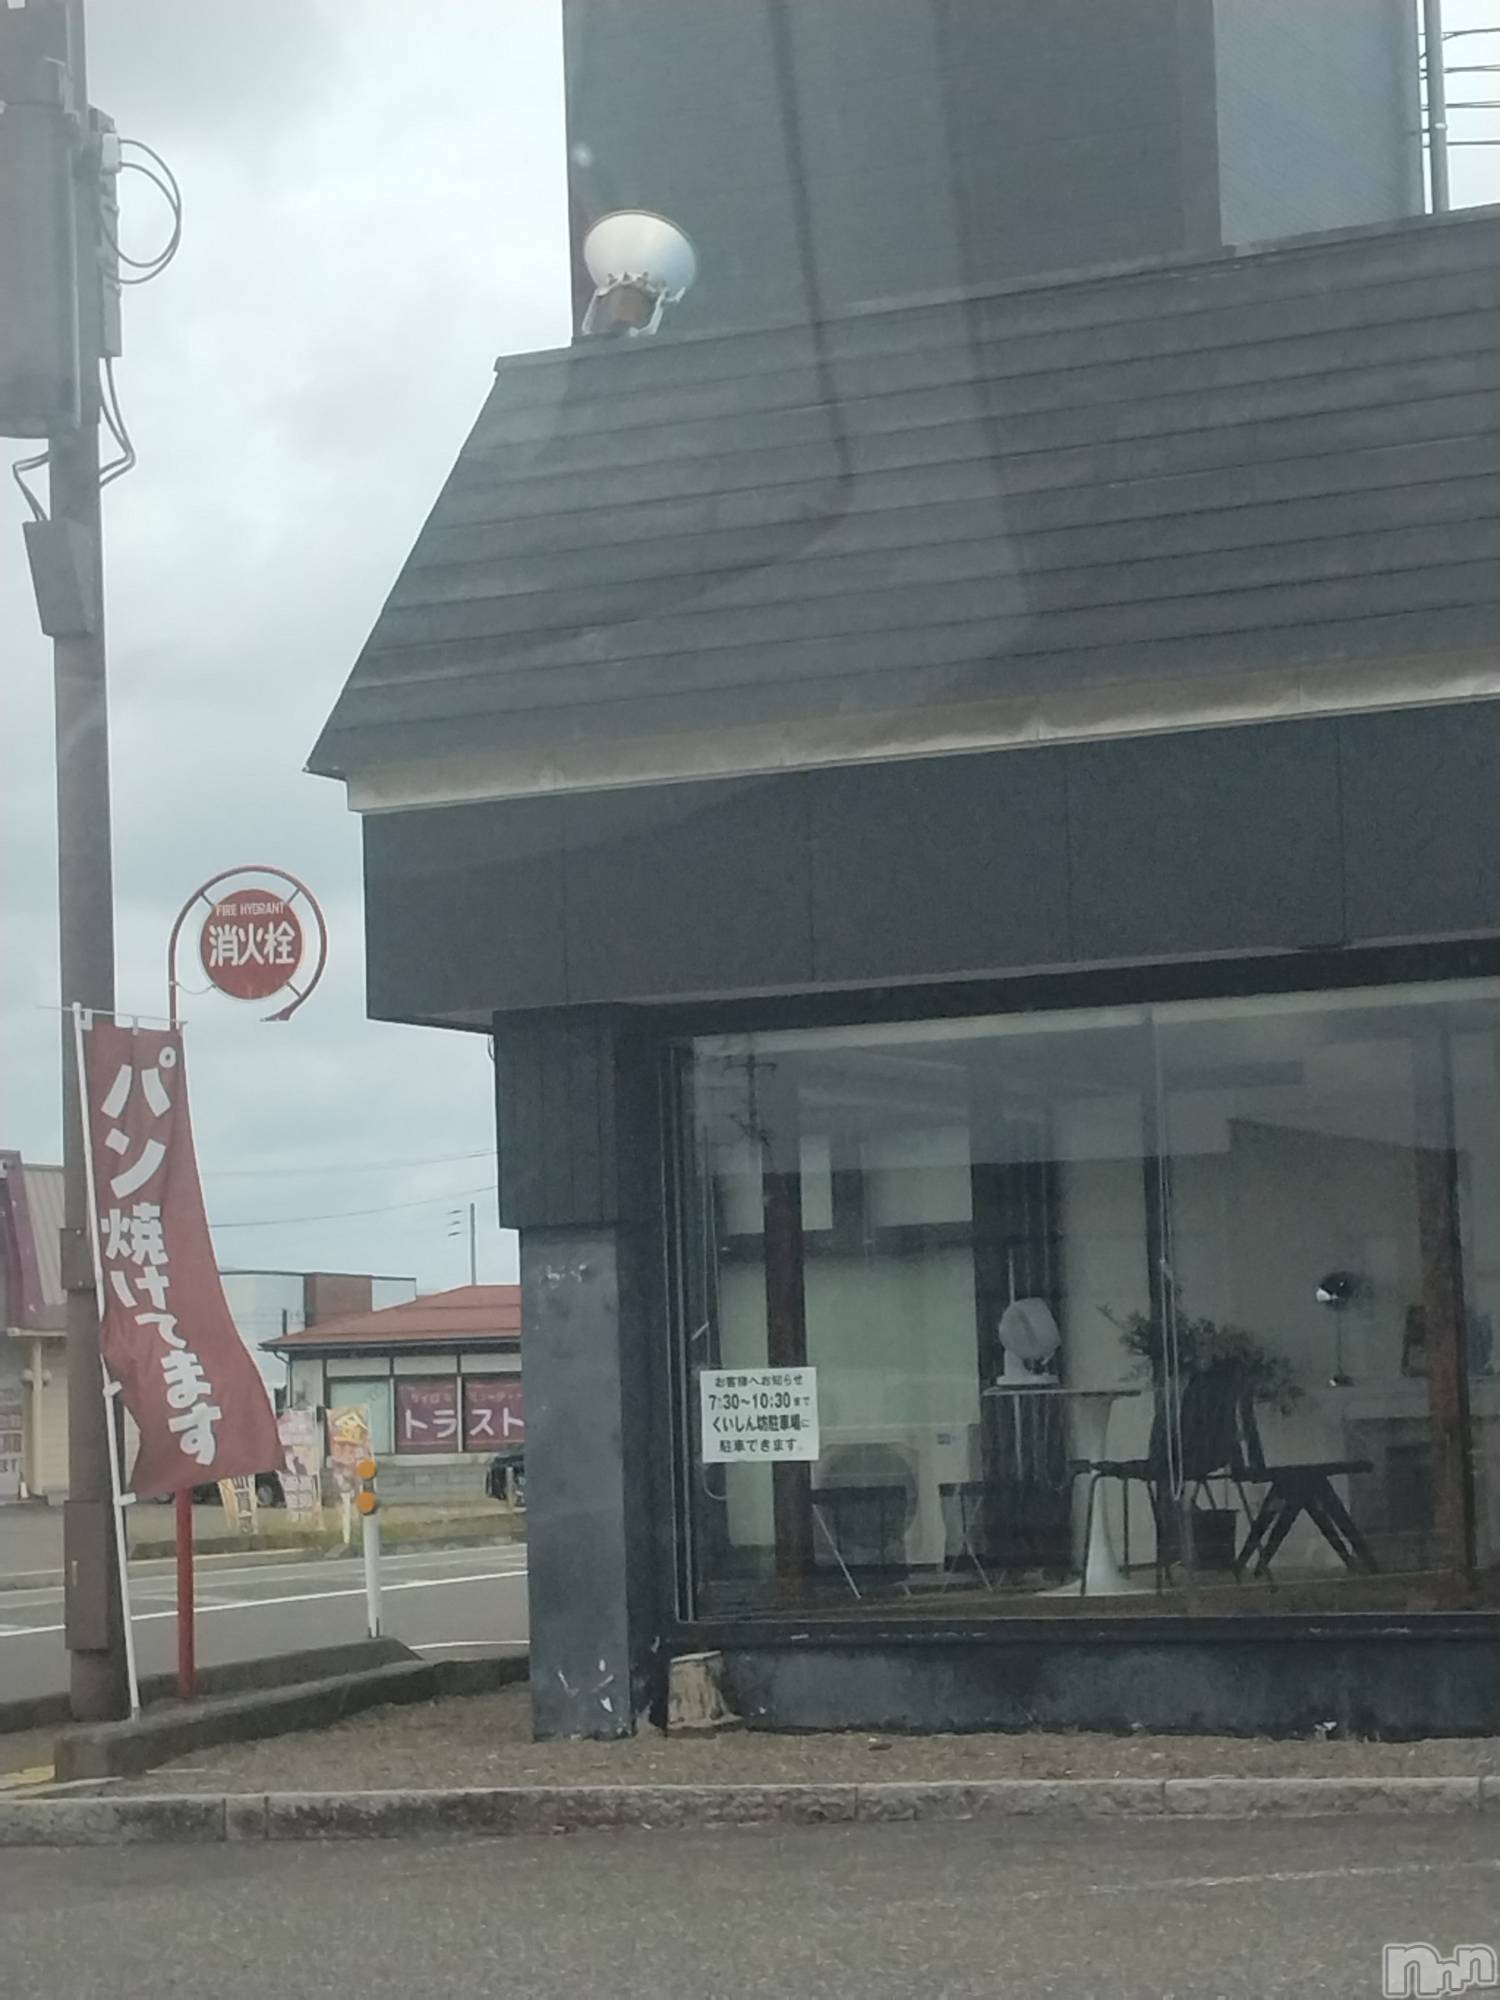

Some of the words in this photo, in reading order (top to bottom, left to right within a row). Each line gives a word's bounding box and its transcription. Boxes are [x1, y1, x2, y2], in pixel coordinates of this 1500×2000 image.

[215, 904, 237, 916] FIRE
[240, 902, 284, 915] HYDRANT
[209, 921, 295, 967] 消火栓
[101, 1046, 223, 1466] パン焼けてます
[715, 1374, 803, 1388] お客様へお知らせ
[405, 1407, 525, 1440] トラスト
